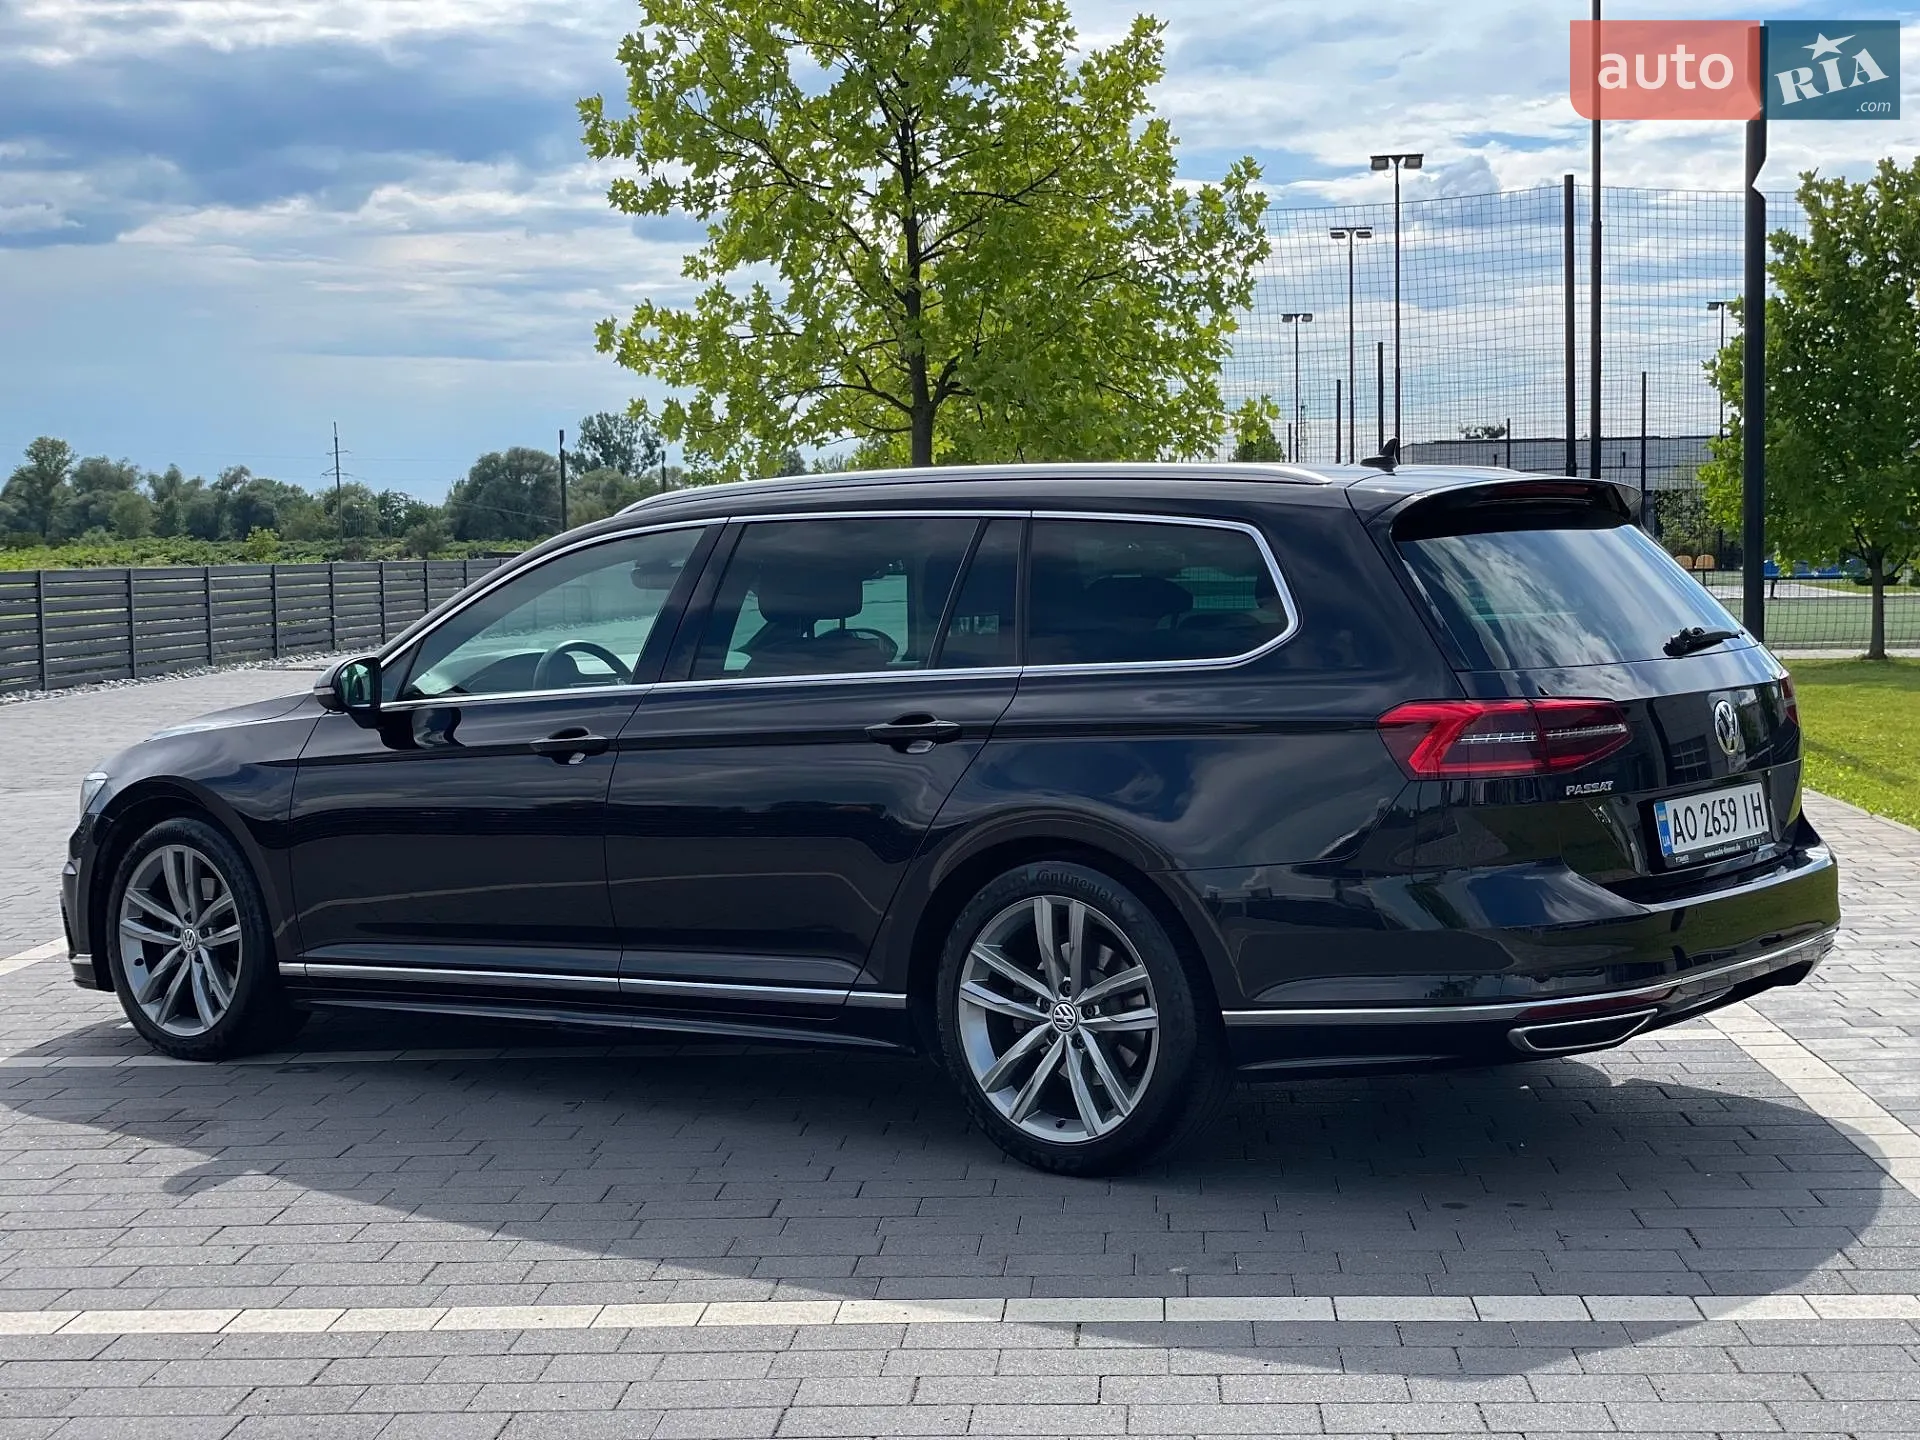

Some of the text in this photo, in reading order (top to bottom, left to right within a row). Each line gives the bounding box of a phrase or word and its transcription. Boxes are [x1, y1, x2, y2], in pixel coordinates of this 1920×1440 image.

[1565, 780, 1614, 796] PASSAT
[1673, 791, 1765, 845] AO 2659 IH
